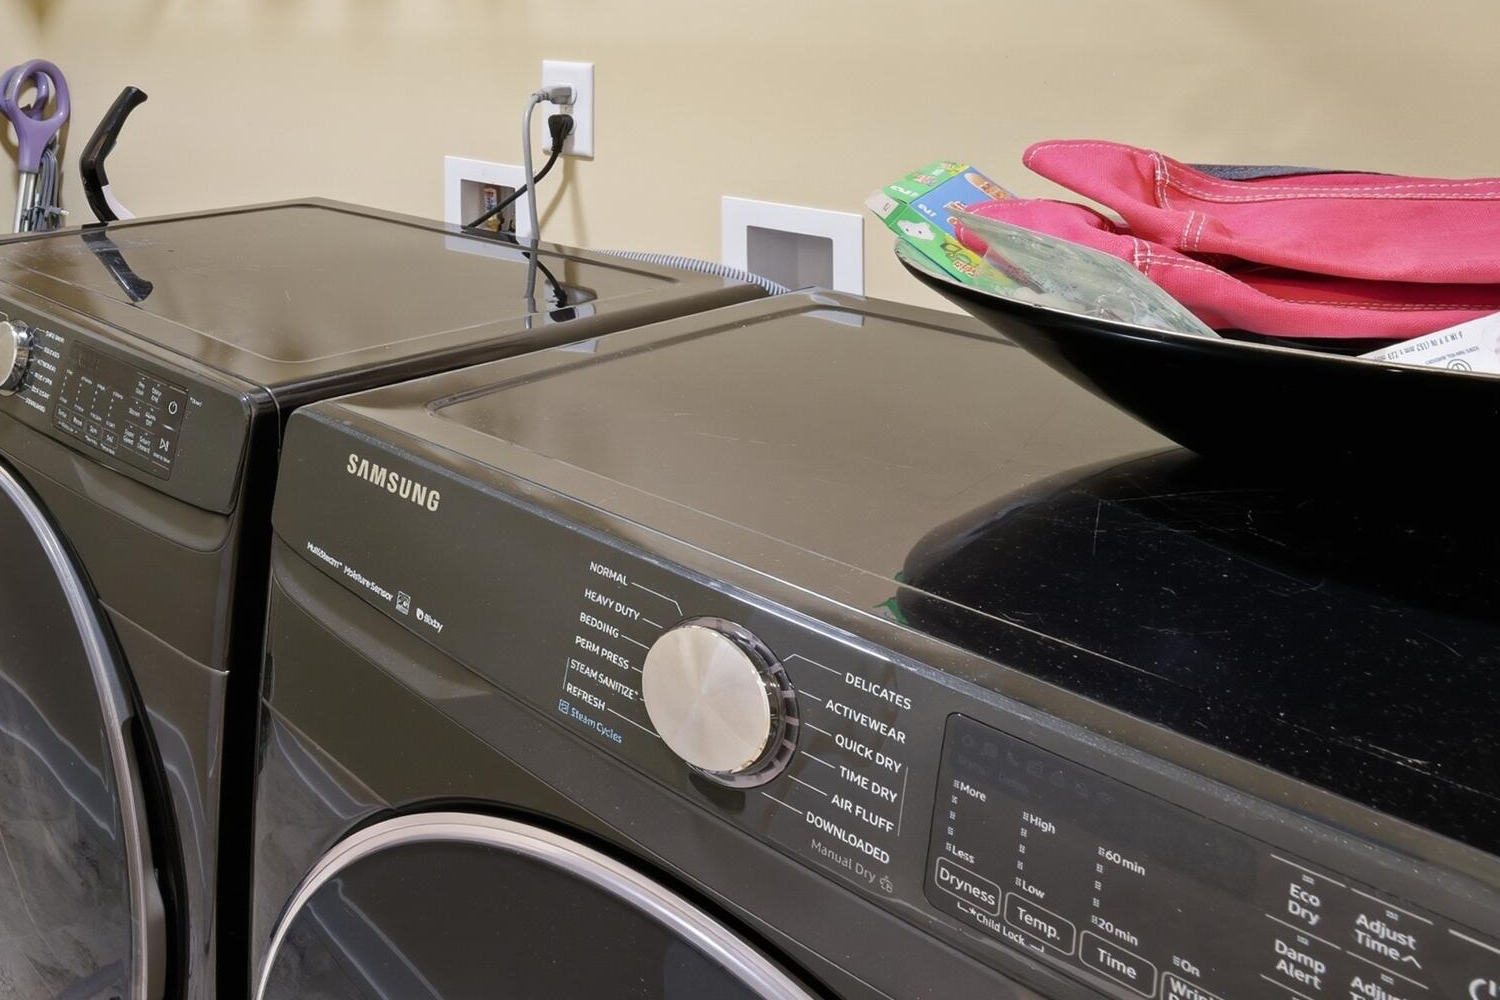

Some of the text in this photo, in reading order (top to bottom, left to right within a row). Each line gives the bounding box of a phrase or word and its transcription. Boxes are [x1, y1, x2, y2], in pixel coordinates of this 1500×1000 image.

[346, 453, 441, 511] SAMSUNG
[589, 561, 628, 586] NORMAL
[370, 582, 393, 602] Sensor
[584, 588, 640, 621] HEAVY DUTY
[579, 612, 619, 639] BEDDING
[575, 635, 629, 670] PERM PRESS
[570, 659, 597, 680] STEAM
[566, 682, 606, 711] REFRESH
[845, 672, 911, 710] DELICATES
[570, 707, 623, 743] Steam Cycles
[825, 699, 906, 744] ACTIVEWEAR
[835, 733, 902, 774] QUICK DRY
[839, 765, 898, 803] TIME DRY
[959, 782, 987, 802] More
[831, 793, 895, 833] AIR FLUFF
[1029, 813, 1056, 835] High
[806, 810, 890, 865] DOWNLOADED
[811, 838, 876, 884] Manual Dry
[951, 845, 975, 864] Less
[1105, 850, 1146, 876] 60 min
[939, 866, 996, 906] Dryness
[1022, 880, 1046, 899] Low
[1289, 883, 1320, 907] Eco
[1016, 906, 1061, 941] Temp.
[1288, 899, 1320, 926] Dry
[1002, 925, 1026, 947] Lock
[1098, 918, 1139, 946] 20 min
[1354, 929, 1400, 961] Time
[1355, 914, 1417, 950] Adjust
[1097, 947, 1137, 980] Time
[1180, 959, 1201, 978] On
[1274, 939, 1326, 974] Damp
[1276, 959, 1322, 990] Alert
